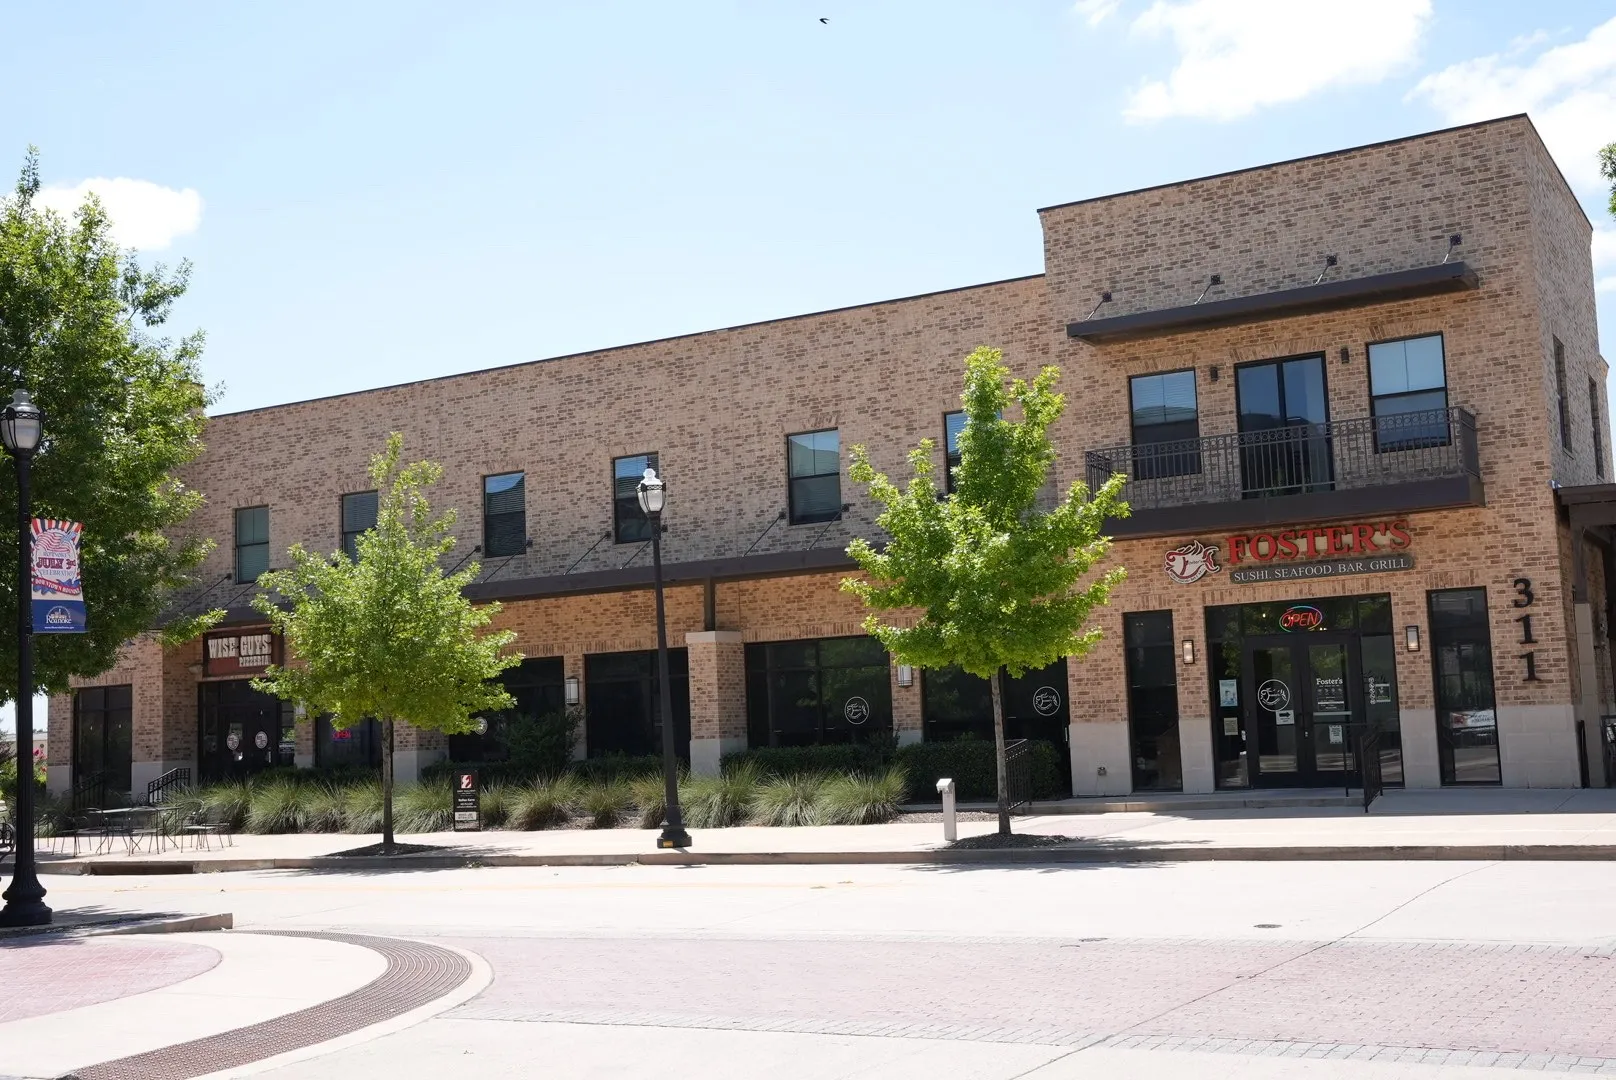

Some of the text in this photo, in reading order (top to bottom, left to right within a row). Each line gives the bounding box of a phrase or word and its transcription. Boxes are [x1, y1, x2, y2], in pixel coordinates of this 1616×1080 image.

[1225, 520, 1412, 564] FOSTER'S
[36, 557, 64, 569] JULY
[1370, 558, 1408, 570] GRILL
[1281, 611, 1320, 627] OPEN
[207, 634, 272, 658] WISE GUYS
[239, 655, 271, 667] PIZZERIA
[1316, 677, 1343, 685] Foster's
